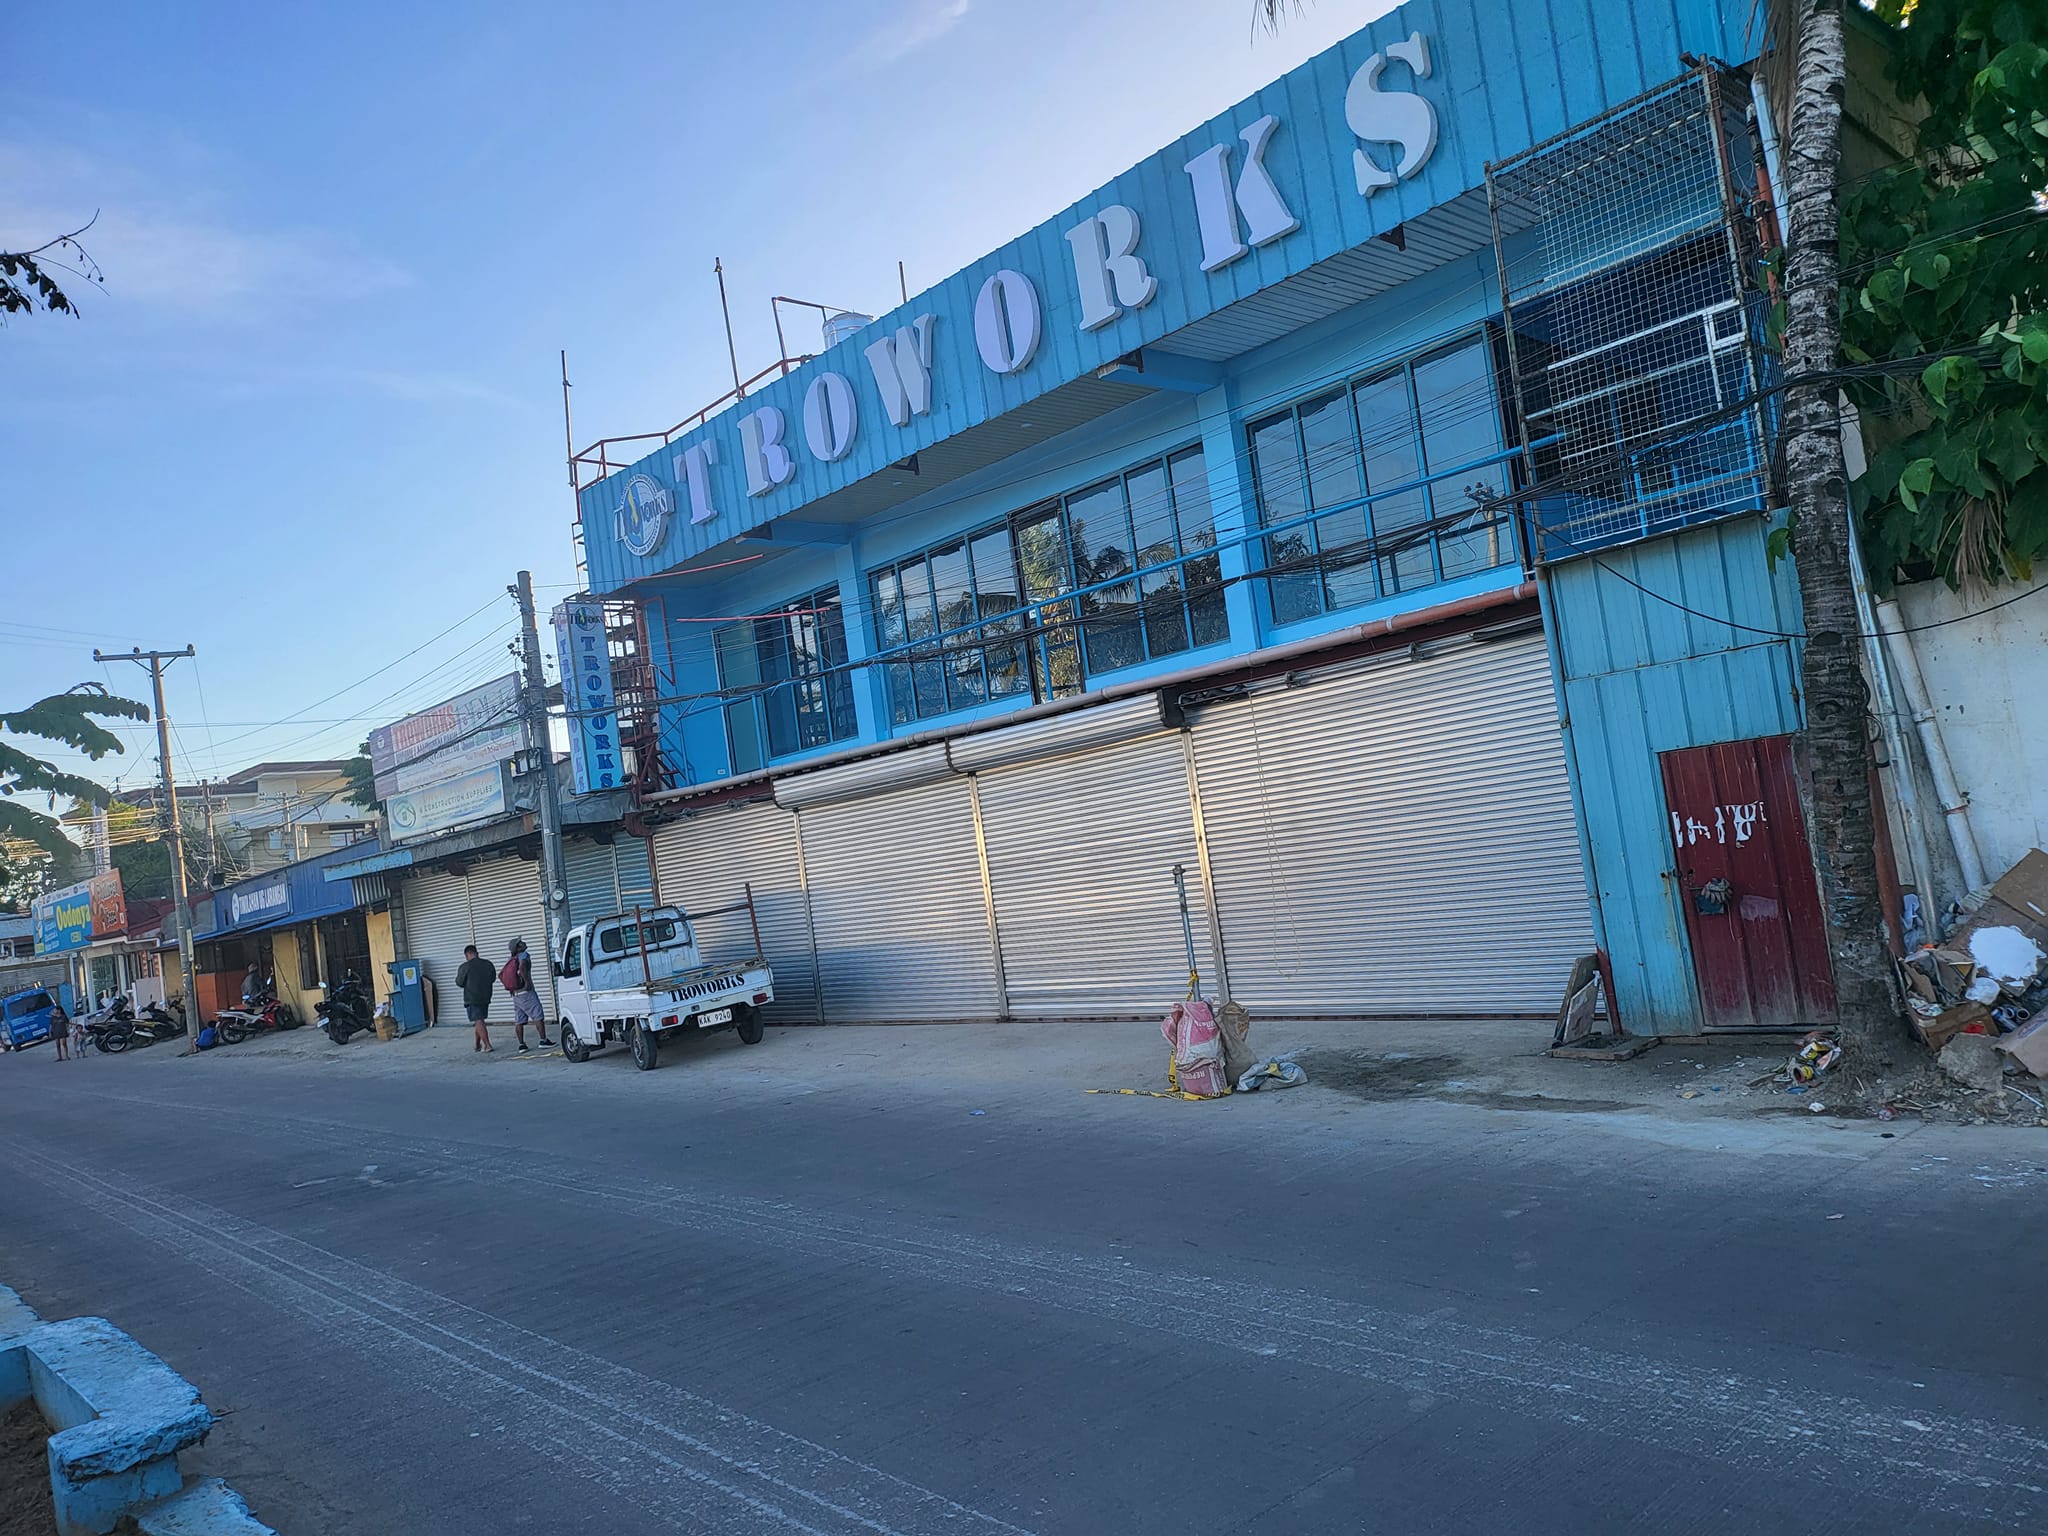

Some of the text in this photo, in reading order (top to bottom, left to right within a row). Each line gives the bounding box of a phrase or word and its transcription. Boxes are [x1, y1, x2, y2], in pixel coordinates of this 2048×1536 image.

[673, 31, 1438, 526] TROWORKS
[559, 638, 586, 793] TROORKS
[581, 636, 614, 788] TROWORKS
[424, 794, 465, 813] CONSTRUCTION
[466, 784, 493, 802] SUPPLIES
[668, 973, 745, 1002] TROWORKS
